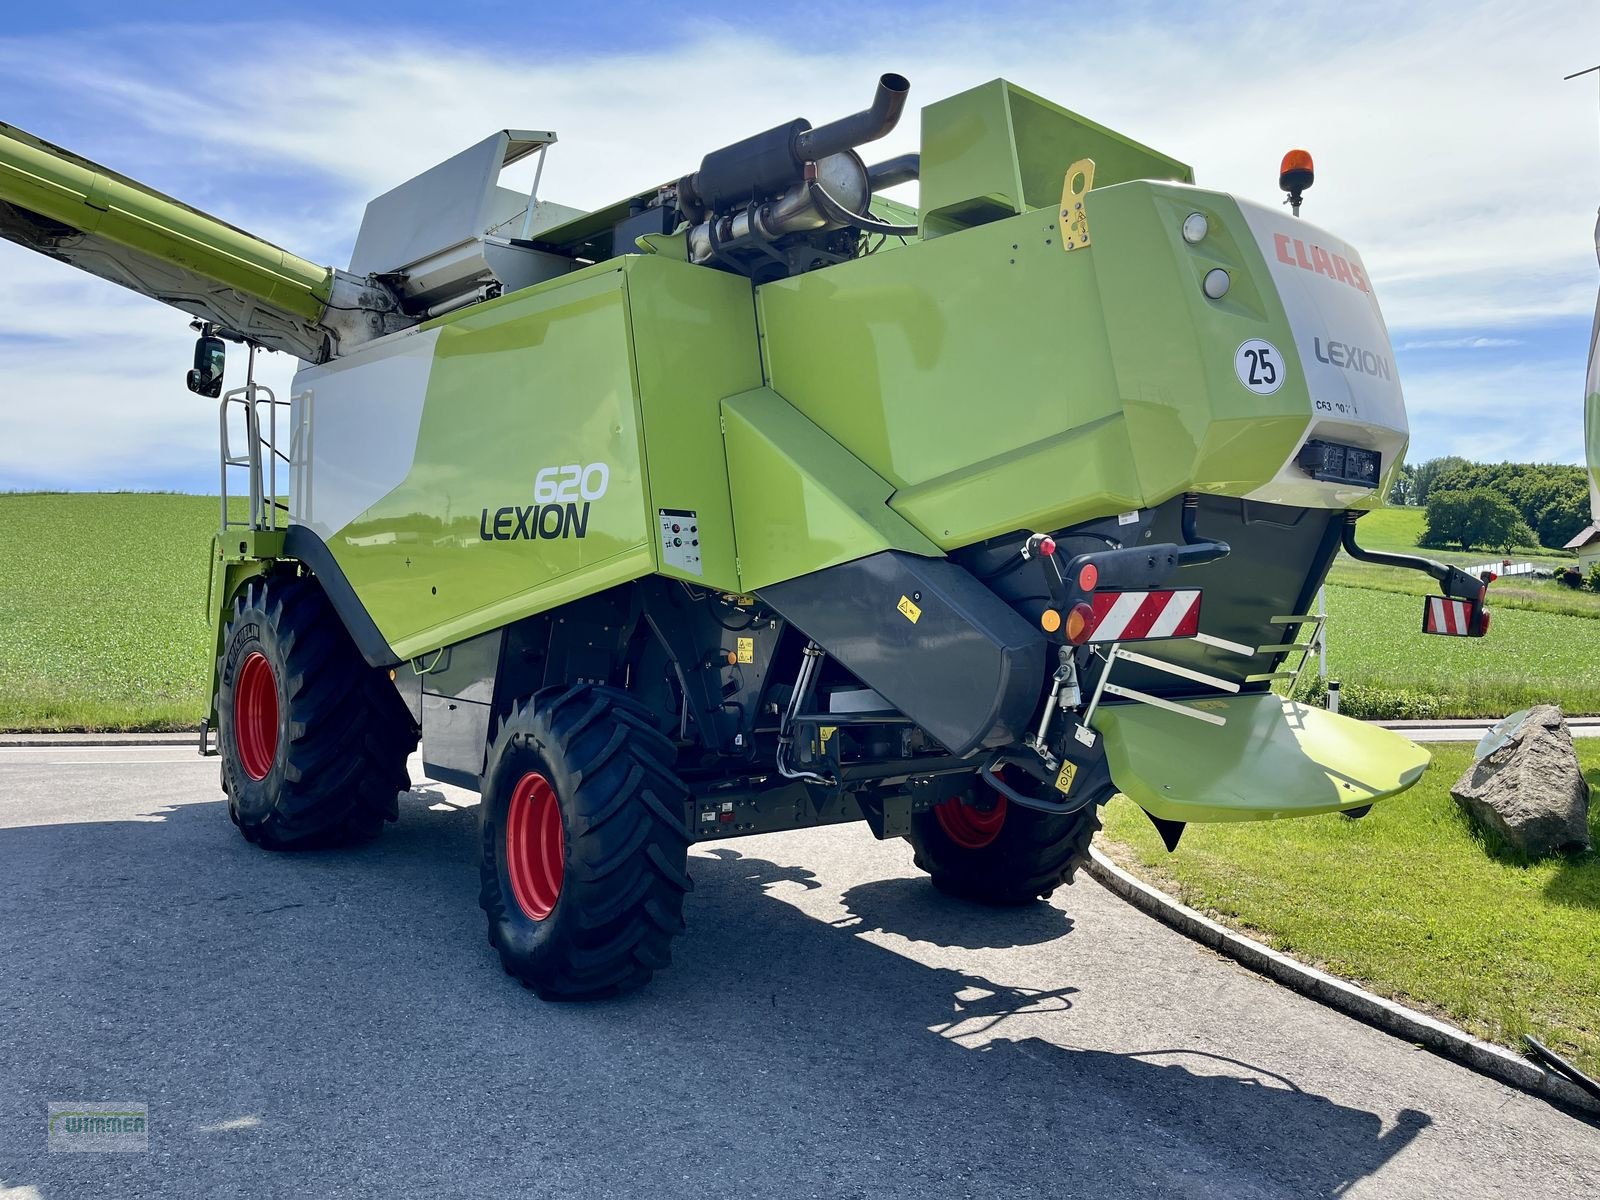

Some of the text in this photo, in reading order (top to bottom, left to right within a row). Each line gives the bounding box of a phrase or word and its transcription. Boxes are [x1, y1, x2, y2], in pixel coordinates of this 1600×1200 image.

[1273, 233, 1369, 293] CLAAS
[1244, 349, 1276, 385] 25
[1314, 337, 1391, 381] LEXION
[534, 462, 609, 504] 620
[480, 502, 590, 540] LEXION
